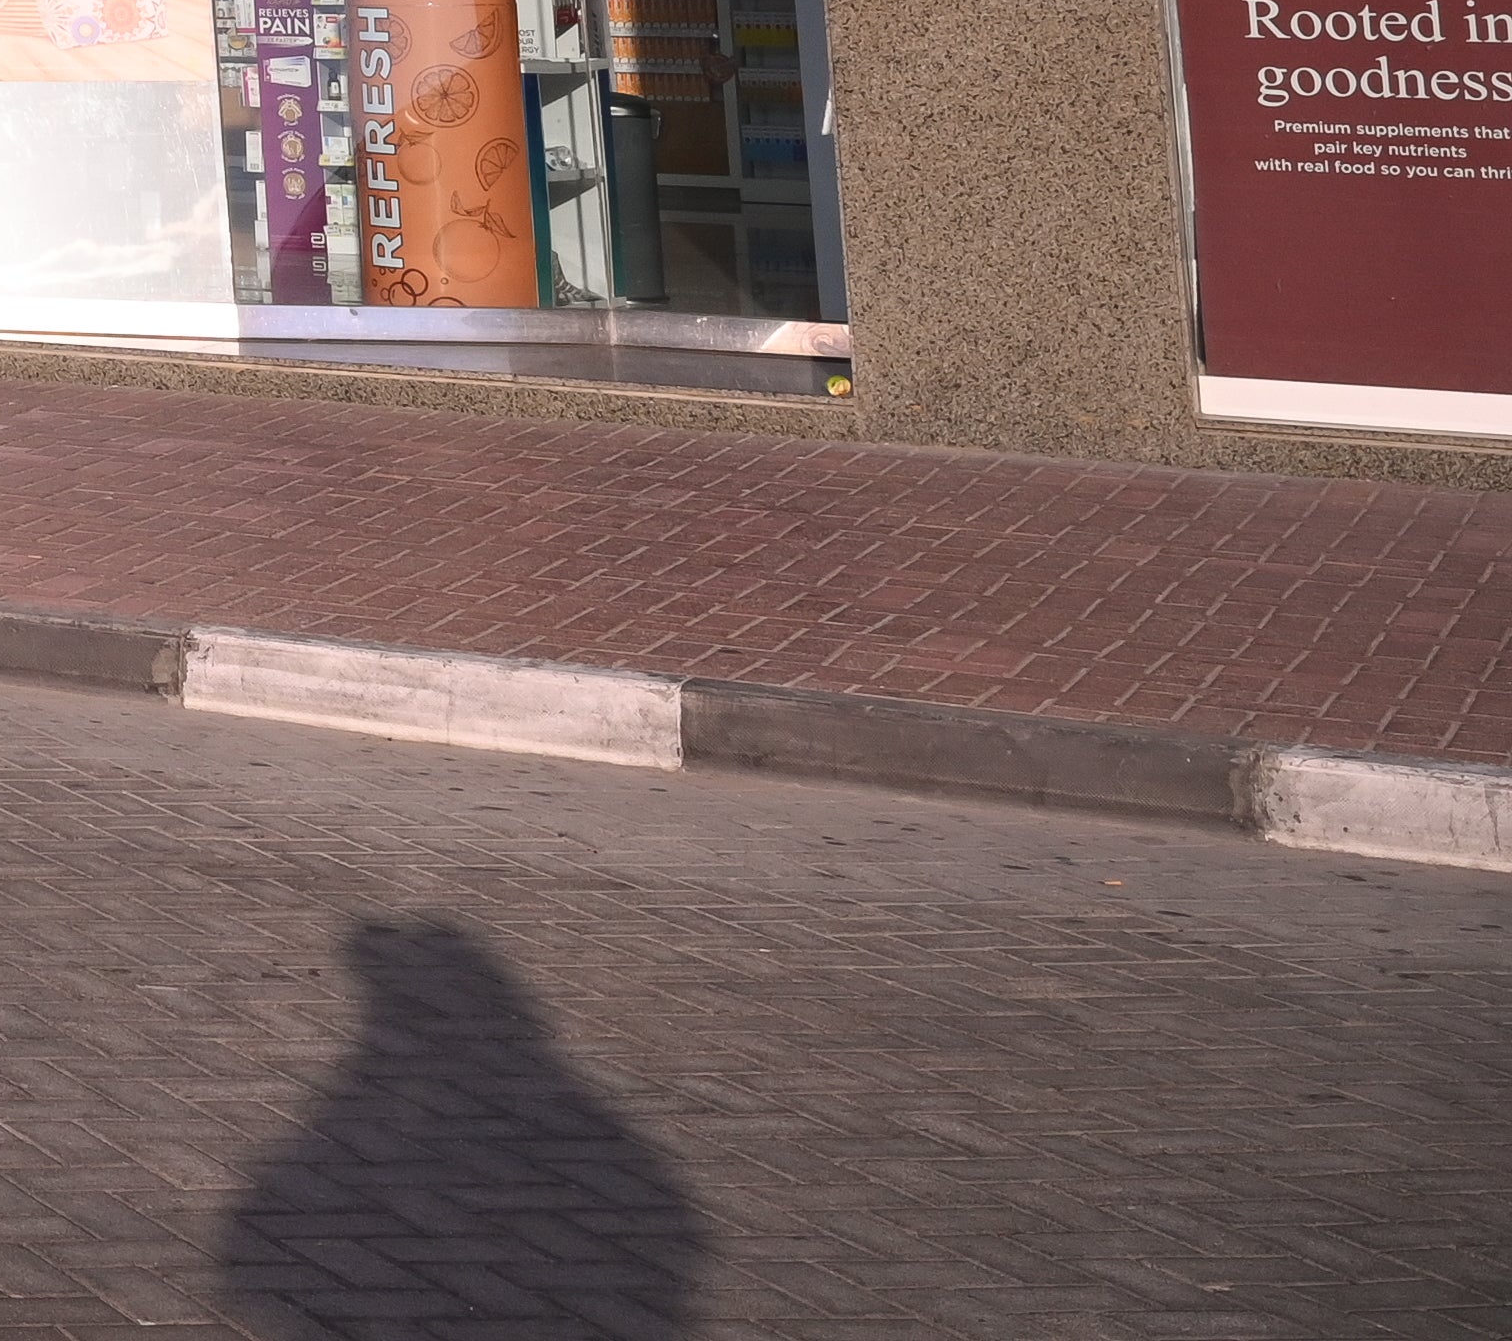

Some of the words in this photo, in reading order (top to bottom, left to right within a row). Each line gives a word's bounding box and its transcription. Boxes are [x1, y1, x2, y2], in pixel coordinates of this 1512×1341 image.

[258, 8, 309, 18] RELIEVES
[1464, 0, 1512, 44] in
[259, 17, 311, 36] PAIN
[1257, 55, 1512, 107] goodness
[357, 6, 404, 270] REFRESH
[1274, 120, 1351, 135] Premium
[1356, 121, 1469, 139] supplements
[1474, 125, 1510, 140] that
[1314, 141, 1348, 155] pair
[1353, 141, 1383, 158] key
[1388, 144, 1467, 159] nutrients
[1255, 158, 1292, 171] with
[1297, 159, 1329, 173] real
[1335, 160, 1375, 175] food
[1381, 165, 1400, 176] so
[1406, 165, 1438, 178] you
[1443, 166, 1475, 178] can
